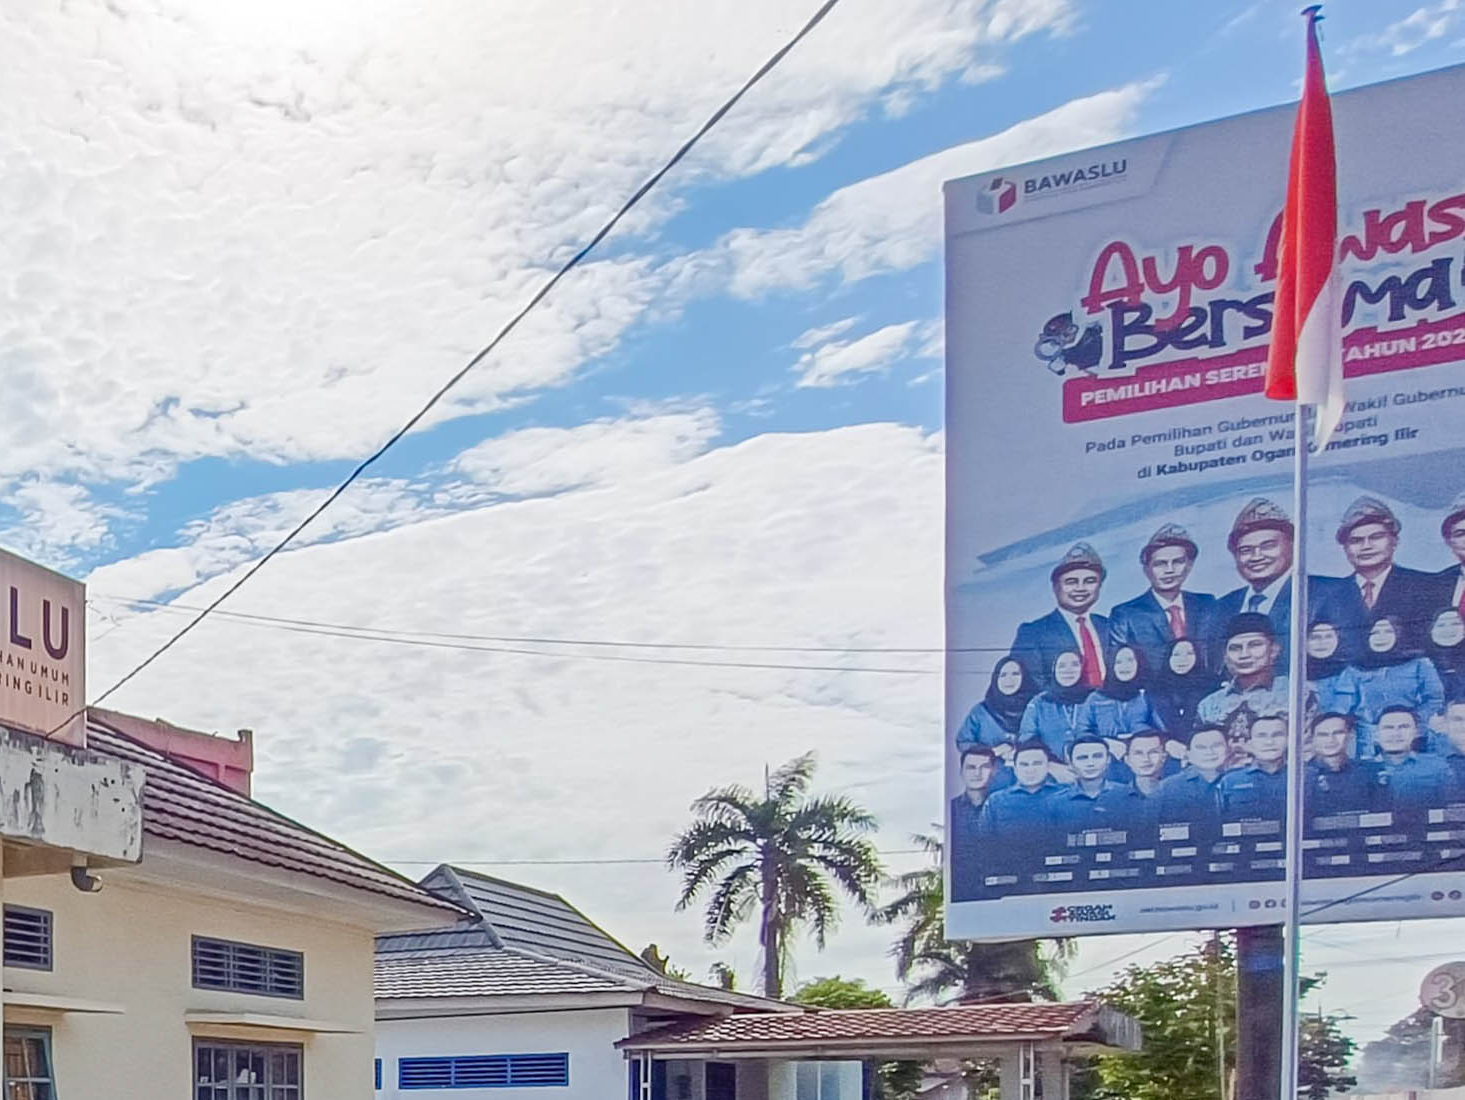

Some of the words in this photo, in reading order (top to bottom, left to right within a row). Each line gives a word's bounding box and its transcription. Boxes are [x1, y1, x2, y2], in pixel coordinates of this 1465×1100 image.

[1024, 159, 1127, 194] BAWASLU
[1081, 241, 1229, 331] Ayo
[1106, 257, 1456, 370] Bersma
[1081, 372, 1201, 406] PEMILIHAN
[1205, 361, 1271, 386] SERE
[1342, 337, 1417, 362] AHUN
[1086, 437, 1126, 454] Pada
[1131, 425, 1213, 447] Pemilihan
[1217, 411, 1295, 433] Gubernur
[1137, 465, 1152, 479] di
[1156, 453, 1247, 476] Kabupaten
[1251, 447, 1295, 463] Ogan
[1395, 426, 1419, 441] Ilir
[1174, 439, 1227, 457] Bupati
[1232, 434, 1263, 448] dan
[30, 661, 69, 687] UMUM
[38, 684, 69, 706] ILIR
